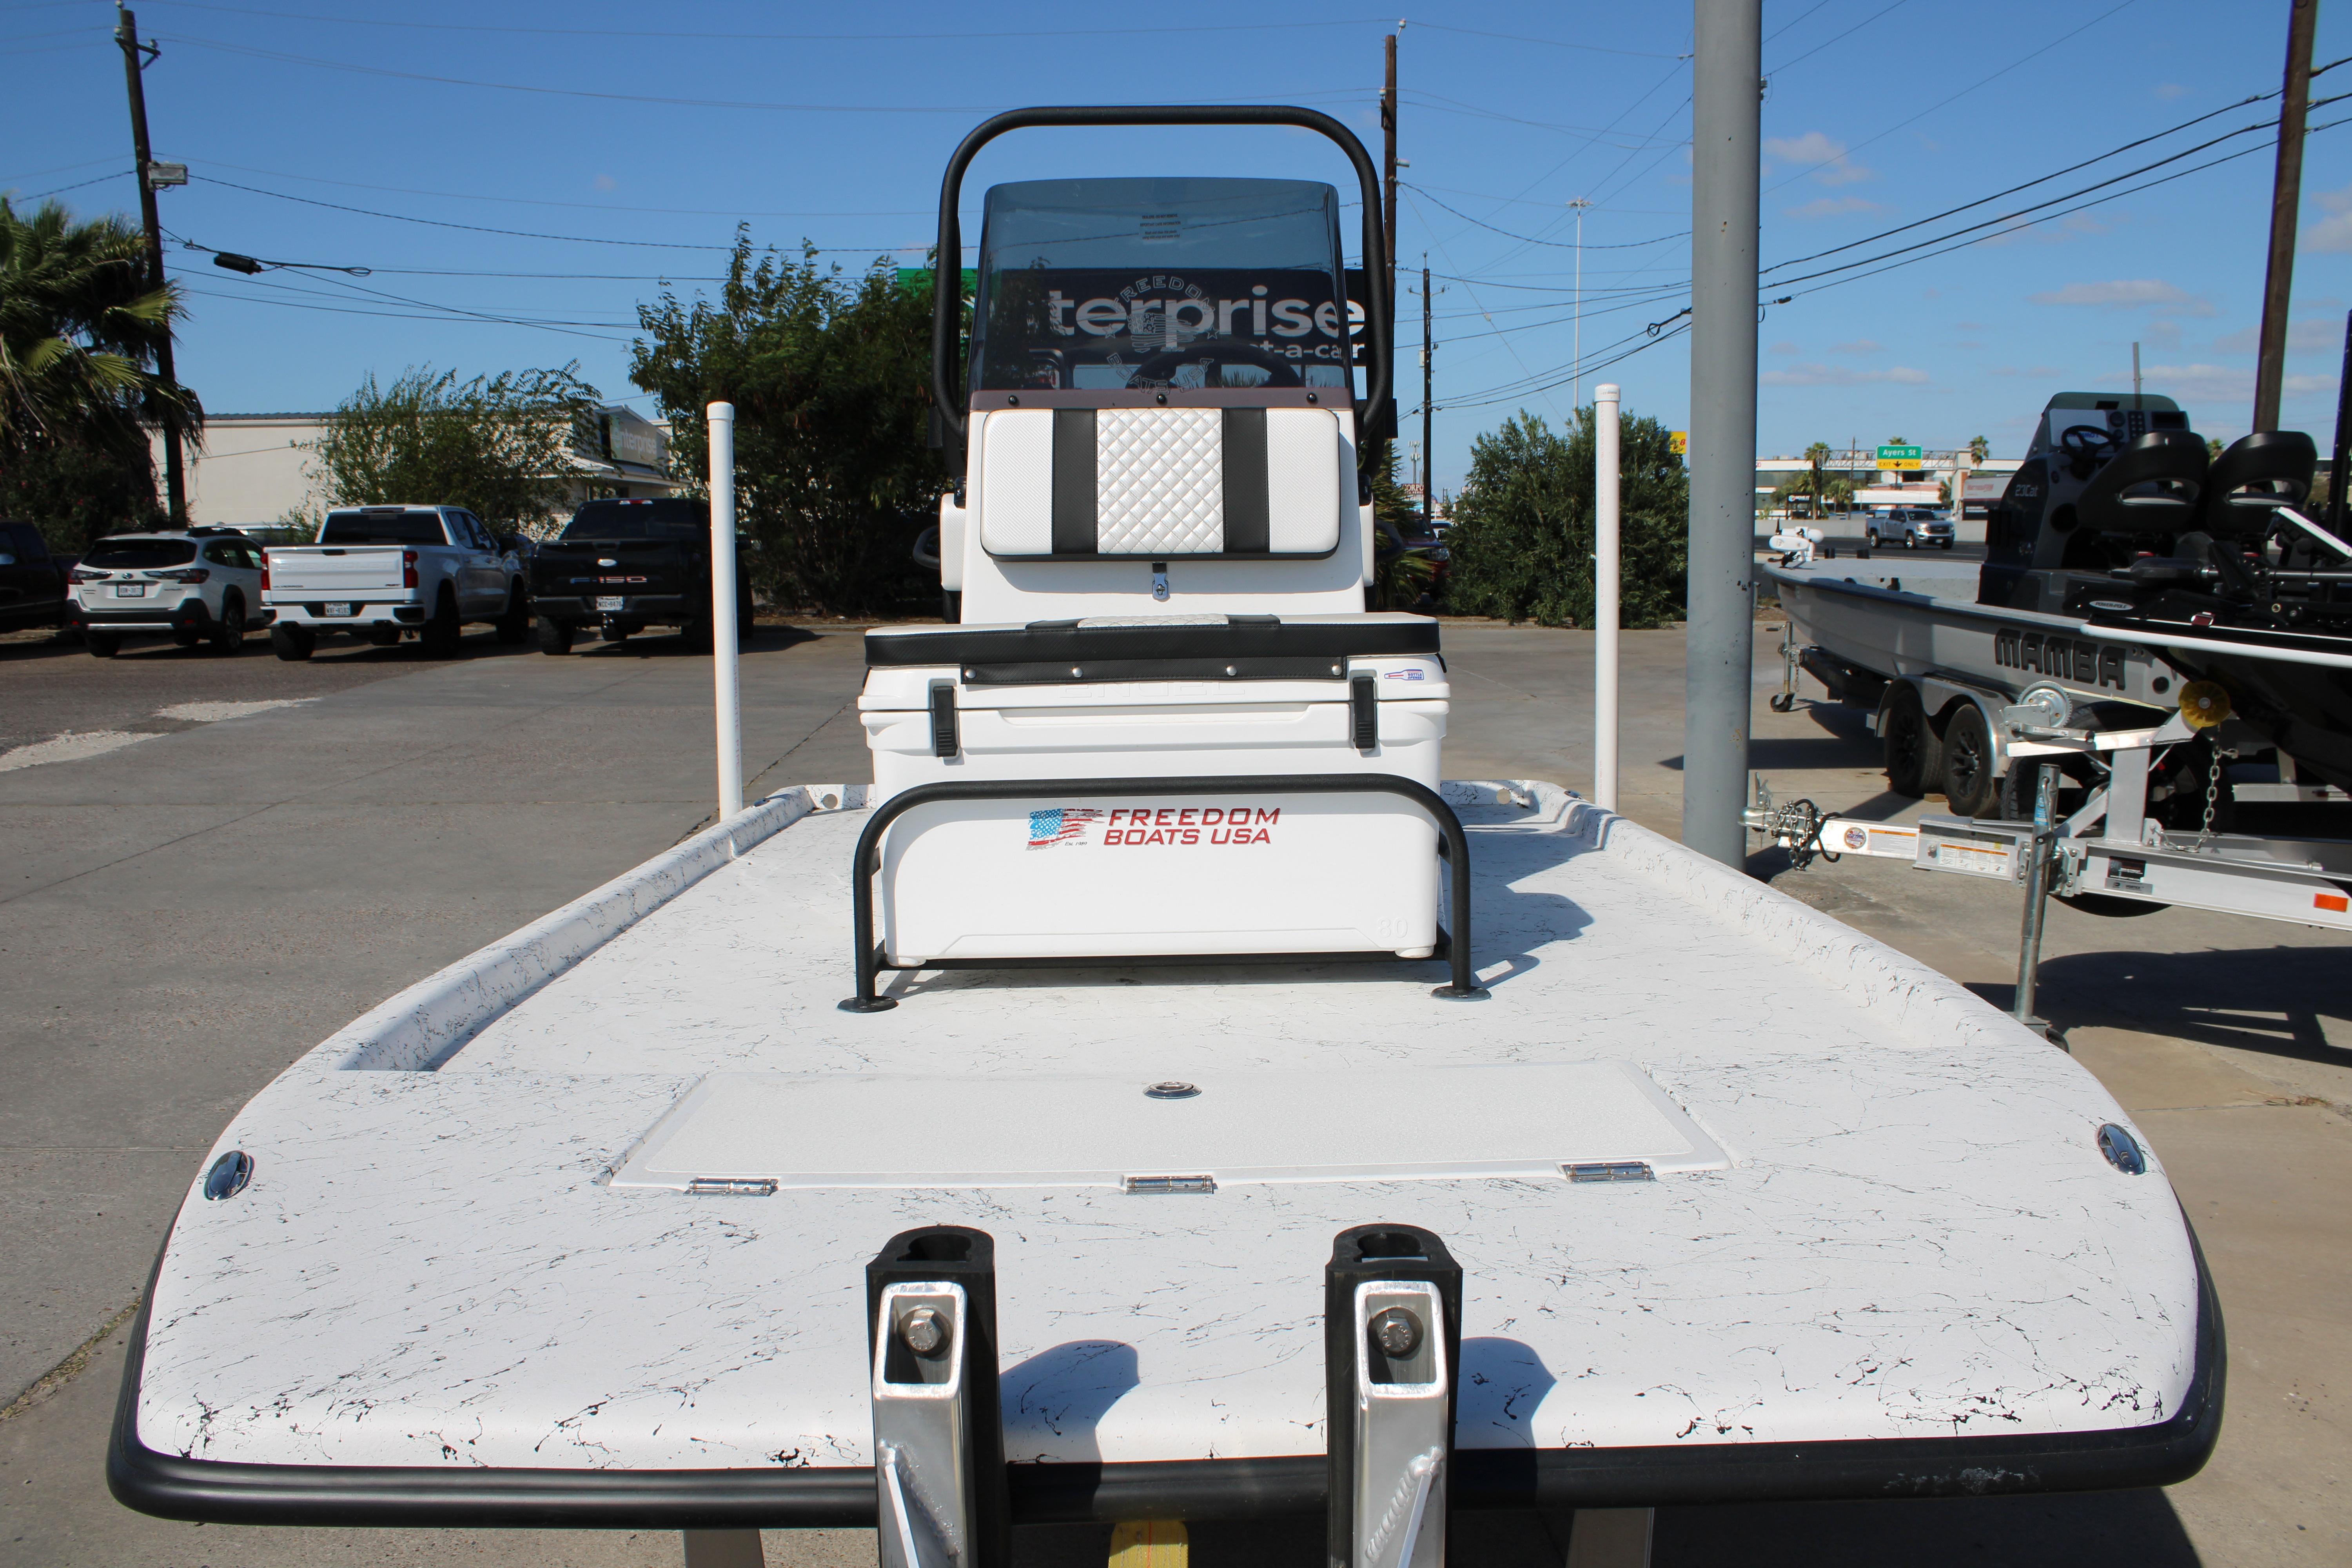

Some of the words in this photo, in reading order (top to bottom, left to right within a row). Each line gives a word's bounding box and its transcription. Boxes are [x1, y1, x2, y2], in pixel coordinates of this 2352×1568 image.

[1110, 276, 1215, 315] FREEDOM
[1049, 285, 1365, 348] terprise
[1259, 340, 1365, 358] t-a-car
[1107, 353, 1171, 396] BOATS
[1174, 358, 1214, 393] USA
[612, 427, 657, 458] enterprise
[1882, 449, 1905, 457] Ayers
[2015, 484, 2038, 497] 23Cat
[1994, 627, 2126, 691] MAMBA
[1109, 807, 1281, 826] FREEDOM
[1103, 828, 1200, 846] BOATS
[1210, 828, 1271, 845] USA
[1377, 916, 1408, 938] 80
